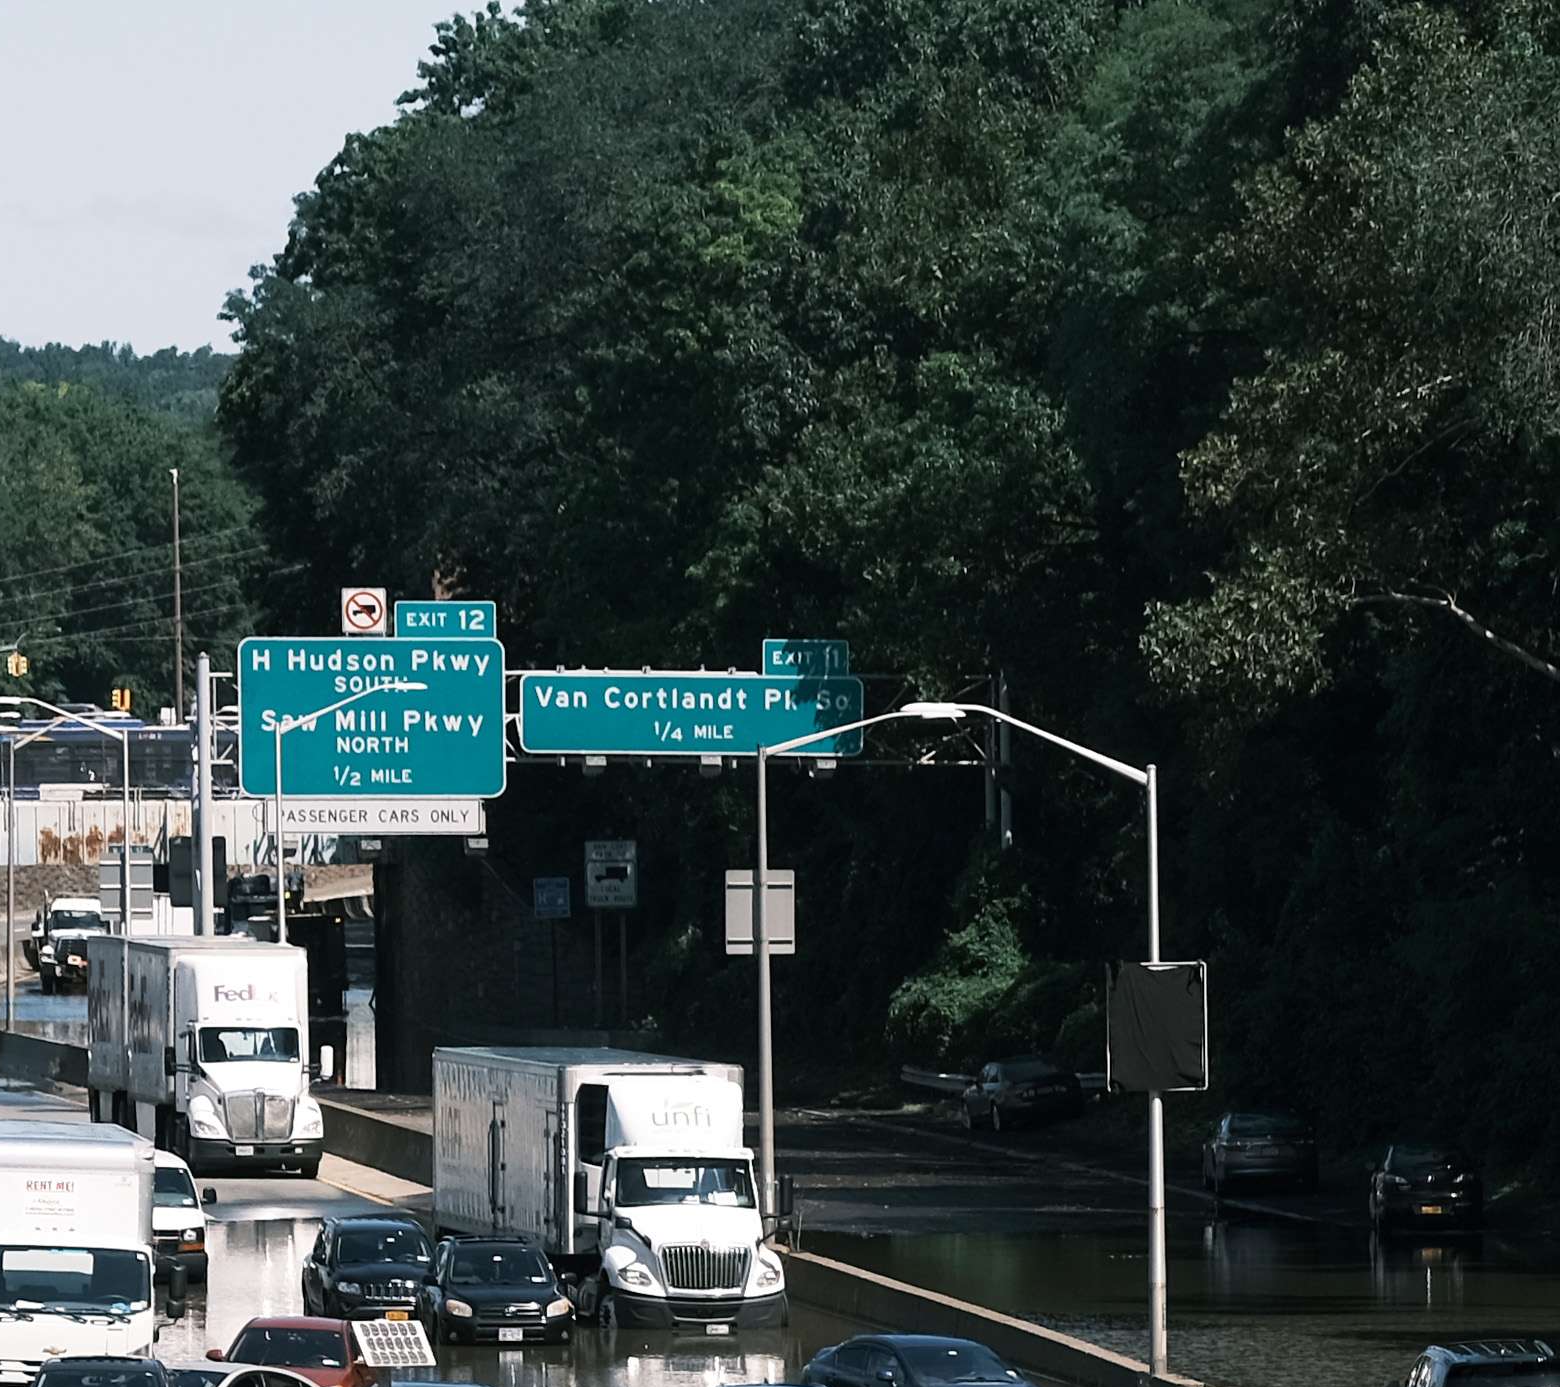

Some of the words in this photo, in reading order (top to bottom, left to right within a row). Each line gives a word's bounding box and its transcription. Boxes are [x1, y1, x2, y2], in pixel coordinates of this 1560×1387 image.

[406, 612, 447, 627] EXIT
[458, 610, 485, 630] 12
[252, 649, 271, 671] H
[288, 649, 395, 671] Hudson
[411, 649, 490, 676] Pkwy
[772, 651, 814, 665] EXIT
[535, 686, 588, 709] Van
[604, 686, 747, 710] Cortlandt
[764, 688, 798, 710] Pk
[335, 710, 387, 732] Mill
[404, 710, 483, 737] Pkwy
[654, 720, 683, 742] 1/4
[694, 725, 733, 739] MILE
[336, 737, 409, 753] NORTH
[333, 765, 361, 786] 1/2
[371, 769, 412, 783] MILE
[281, 810, 368, 823] ASSENGER
[378, 809, 419, 823] CARS
[430, 809, 470, 823] ONLY
[651, 1105, 713, 1128] unfi
